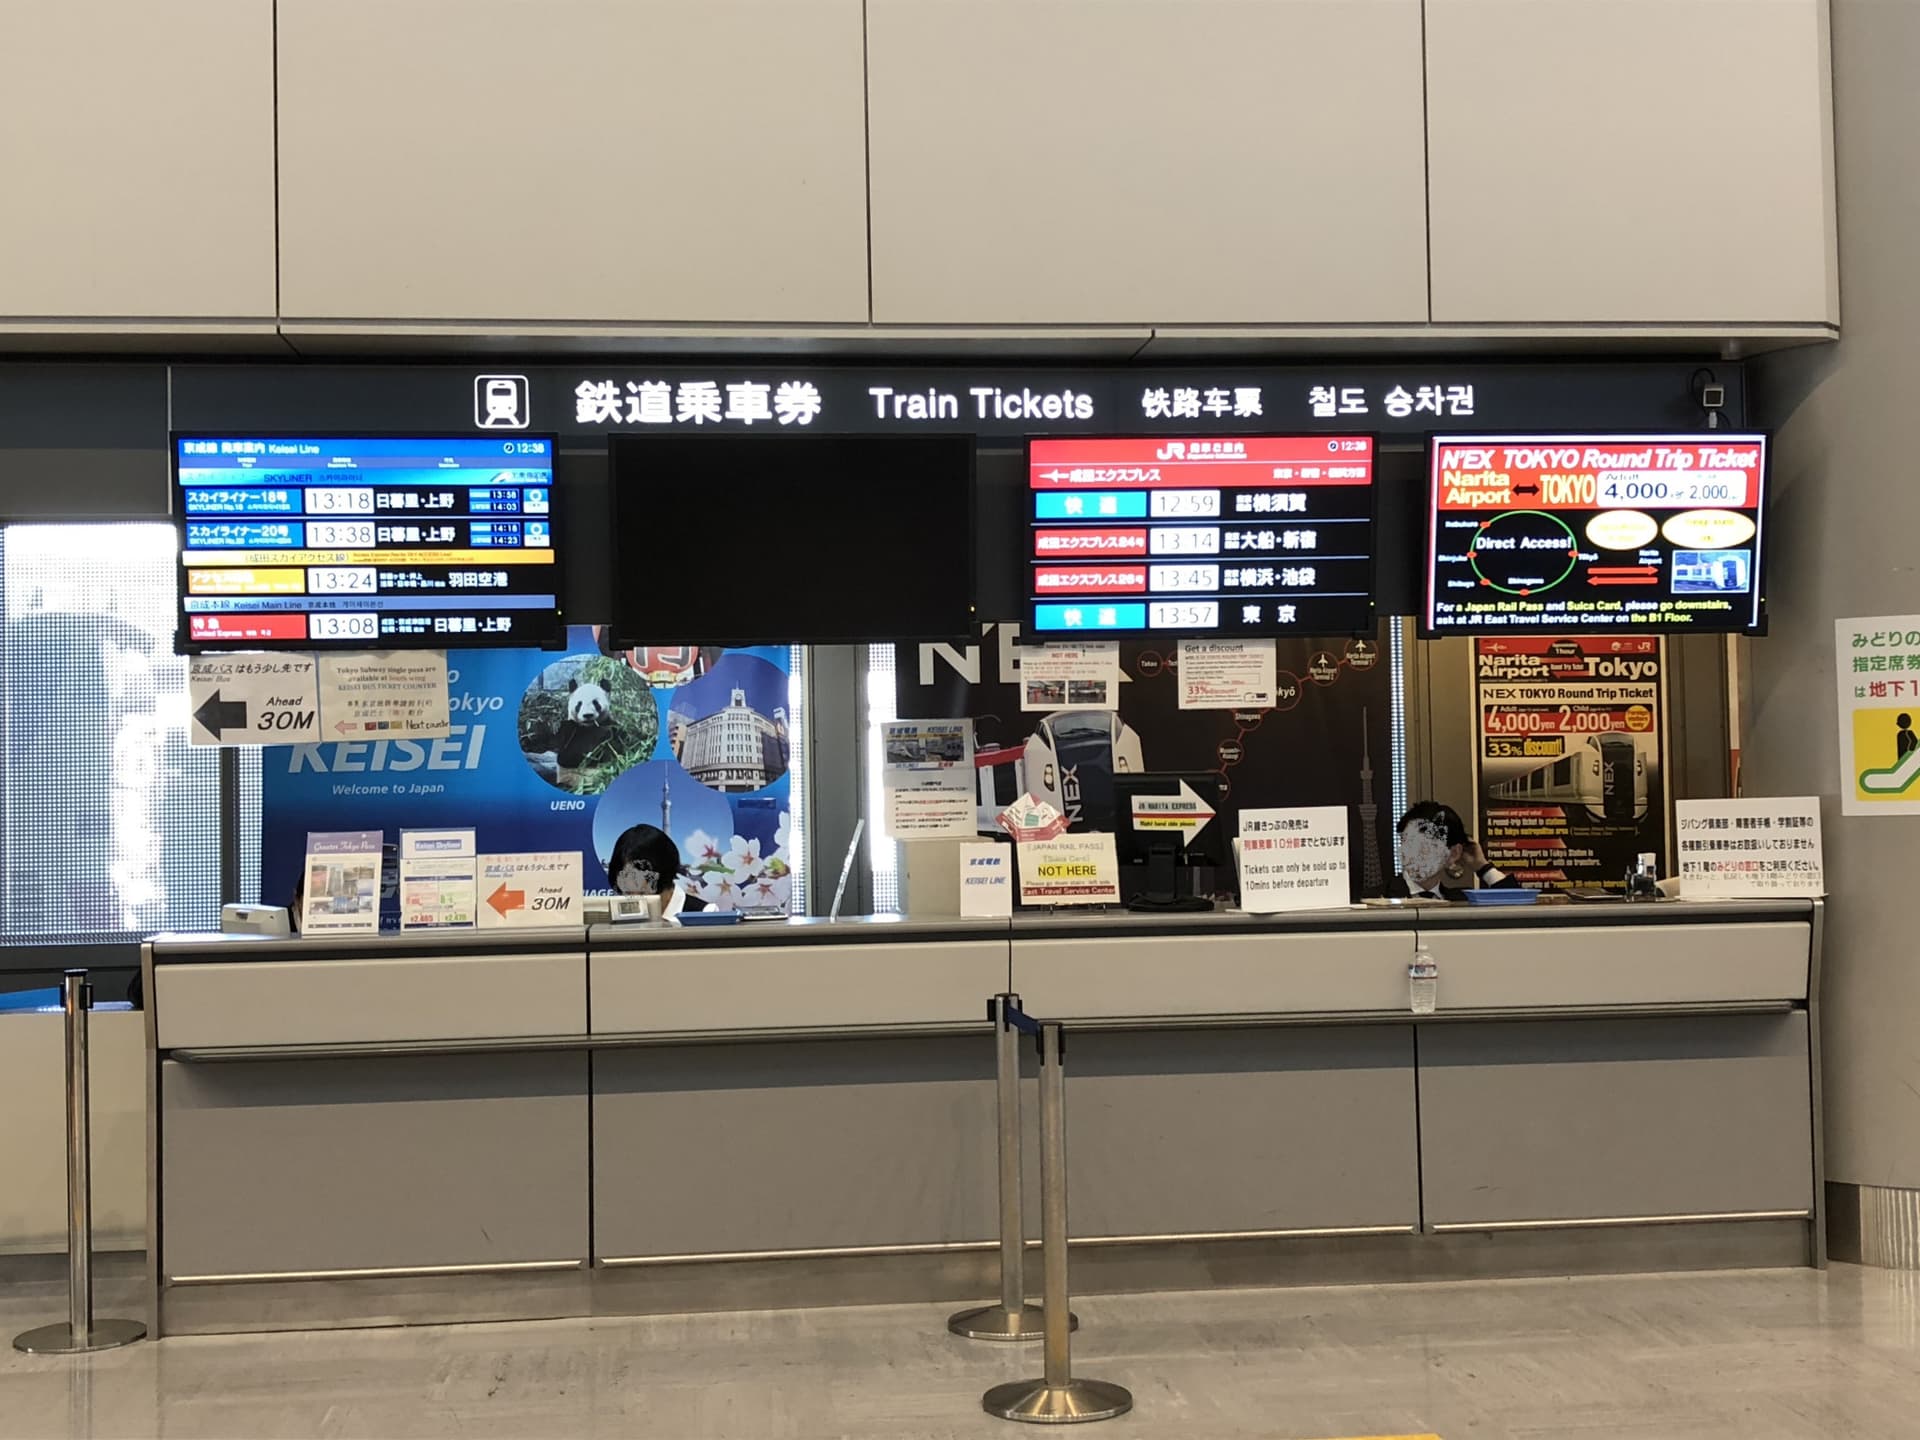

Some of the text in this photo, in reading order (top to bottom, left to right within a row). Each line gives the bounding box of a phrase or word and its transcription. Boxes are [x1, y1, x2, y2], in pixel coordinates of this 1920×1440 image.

[575, 380, 822, 425] 鉄道乗車券
[869, 388, 1094, 419] Train Tickets
[1142, 388, 1263, 418] 铁路车票
[1308, 385, 1475, 418] 철도 승차권
[269, 444, 298, 454] Keisei
[299, 444, 320, 454] Line
[516, 443, 546, 453] 12:38
[1156, 442, 1186, 460] JR
[1441, 448, 1759, 471] N'EX TOKYO Round Trip Ticket
[263, 474, 313, 483] SKYLINER
[1069, 469, 1161, 482] 成田エクスプレス
[1443, 470, 1511, 487] Narita
[1539, 474, 1596, 504] TOKYO
[1604, 482, 1668, 501] 4,000
[1689, 484, 1728, 500] 2,000
[188, 491, 288, 503] スカイライナー18号
[312, 492, 371, 509] 13:18
[376, 493, 455, 509] 日暮里・上野
[1445, 487, 1511, 508] Airport
[493, 503, 517, 511] 14:03
[189, 525, 289, 537] スカイライナー20号
[313, 526, 371, 543] 13:38
[377, 526, 456, 542] 日暮里・上野
[494, 536, 518, 544] 14:23
[1240, 531, 1317, 549] 大船・新宿
[1475, 536, 1572, 549] Direct Access!
[315, 572, 372, 589] 13:24
[448, 571, 509, 588] 羽田空港
[1239, 567, 1316, 587] 横浜・池袋
[234, 601, 302, 609] Keisei Main Line
[1436, 600, 1732, 613] For a Japan Rail Pass and Suica Card, please go downstairs,
[1159, 607, 1212, 624] 13:57
[1242, 604, 1297, 623] 東京
[1436, 612, 1693, 625] ask at JR East Travel Service Center on the B1 Floor.
[317, 618, 374, 634] 13:08
[434, 616, 512, 632] 日暮里・上野
[1637, 641, 1651, 651] JR
[1852, 630, 1920, 648] みどりの
[1184, 644, 1200, 653] Get
[1208, 643, 1244, 653] discount
[1479, 655, 1541, 666] Narita
[1852, 654, 1920, 673] 指定席券
[234, 663, 313, 674] はもう少し先です
[1479, 665, 1550, 679] Airport
[1583, 656, 1658, 681] Tokyo
[266, 695, 303, 706] Ahead
[1519, 688, 1556, 699] TOKYO
[1558, 687, 1594, 699] Round
[1595, 687, 1617, 700] Trip
[1617, 687, 1654, 699] Ticket
[448, 692, 504, 716] okyo
[257, 710, 315, 731] 30M
[405, 719, 425, 729] Next
[1488, 743, 1523, 757] 33%
[331, 783, 445, 796] Welcome to Japan
[550, 800, 585, 811] UENO
[1148, 802, 1169, 810] NARITA
[1171, 802, 1197, 810] EXPRESS
[1243, 819, 1309, 832] JR線きっぷの発売は
[1059, 843, 1077, 851] RAIL
[1038, 865, 1097, 877] NOT HERE
[1244, 861, 1347, 875] Tickets can only be sold up to
[965, 876, 1007, 885] KEISEI LINE
[1245, 877, 1329, 891] 10mins before departure
[538, 886, 564, 894] Ahead
[1023, 888, 1039, 896] East
[1040, 888, 1062, 896] Travel
[1063, 887, 1091, 896] Service
[531, 896, 571, 911] 30M
